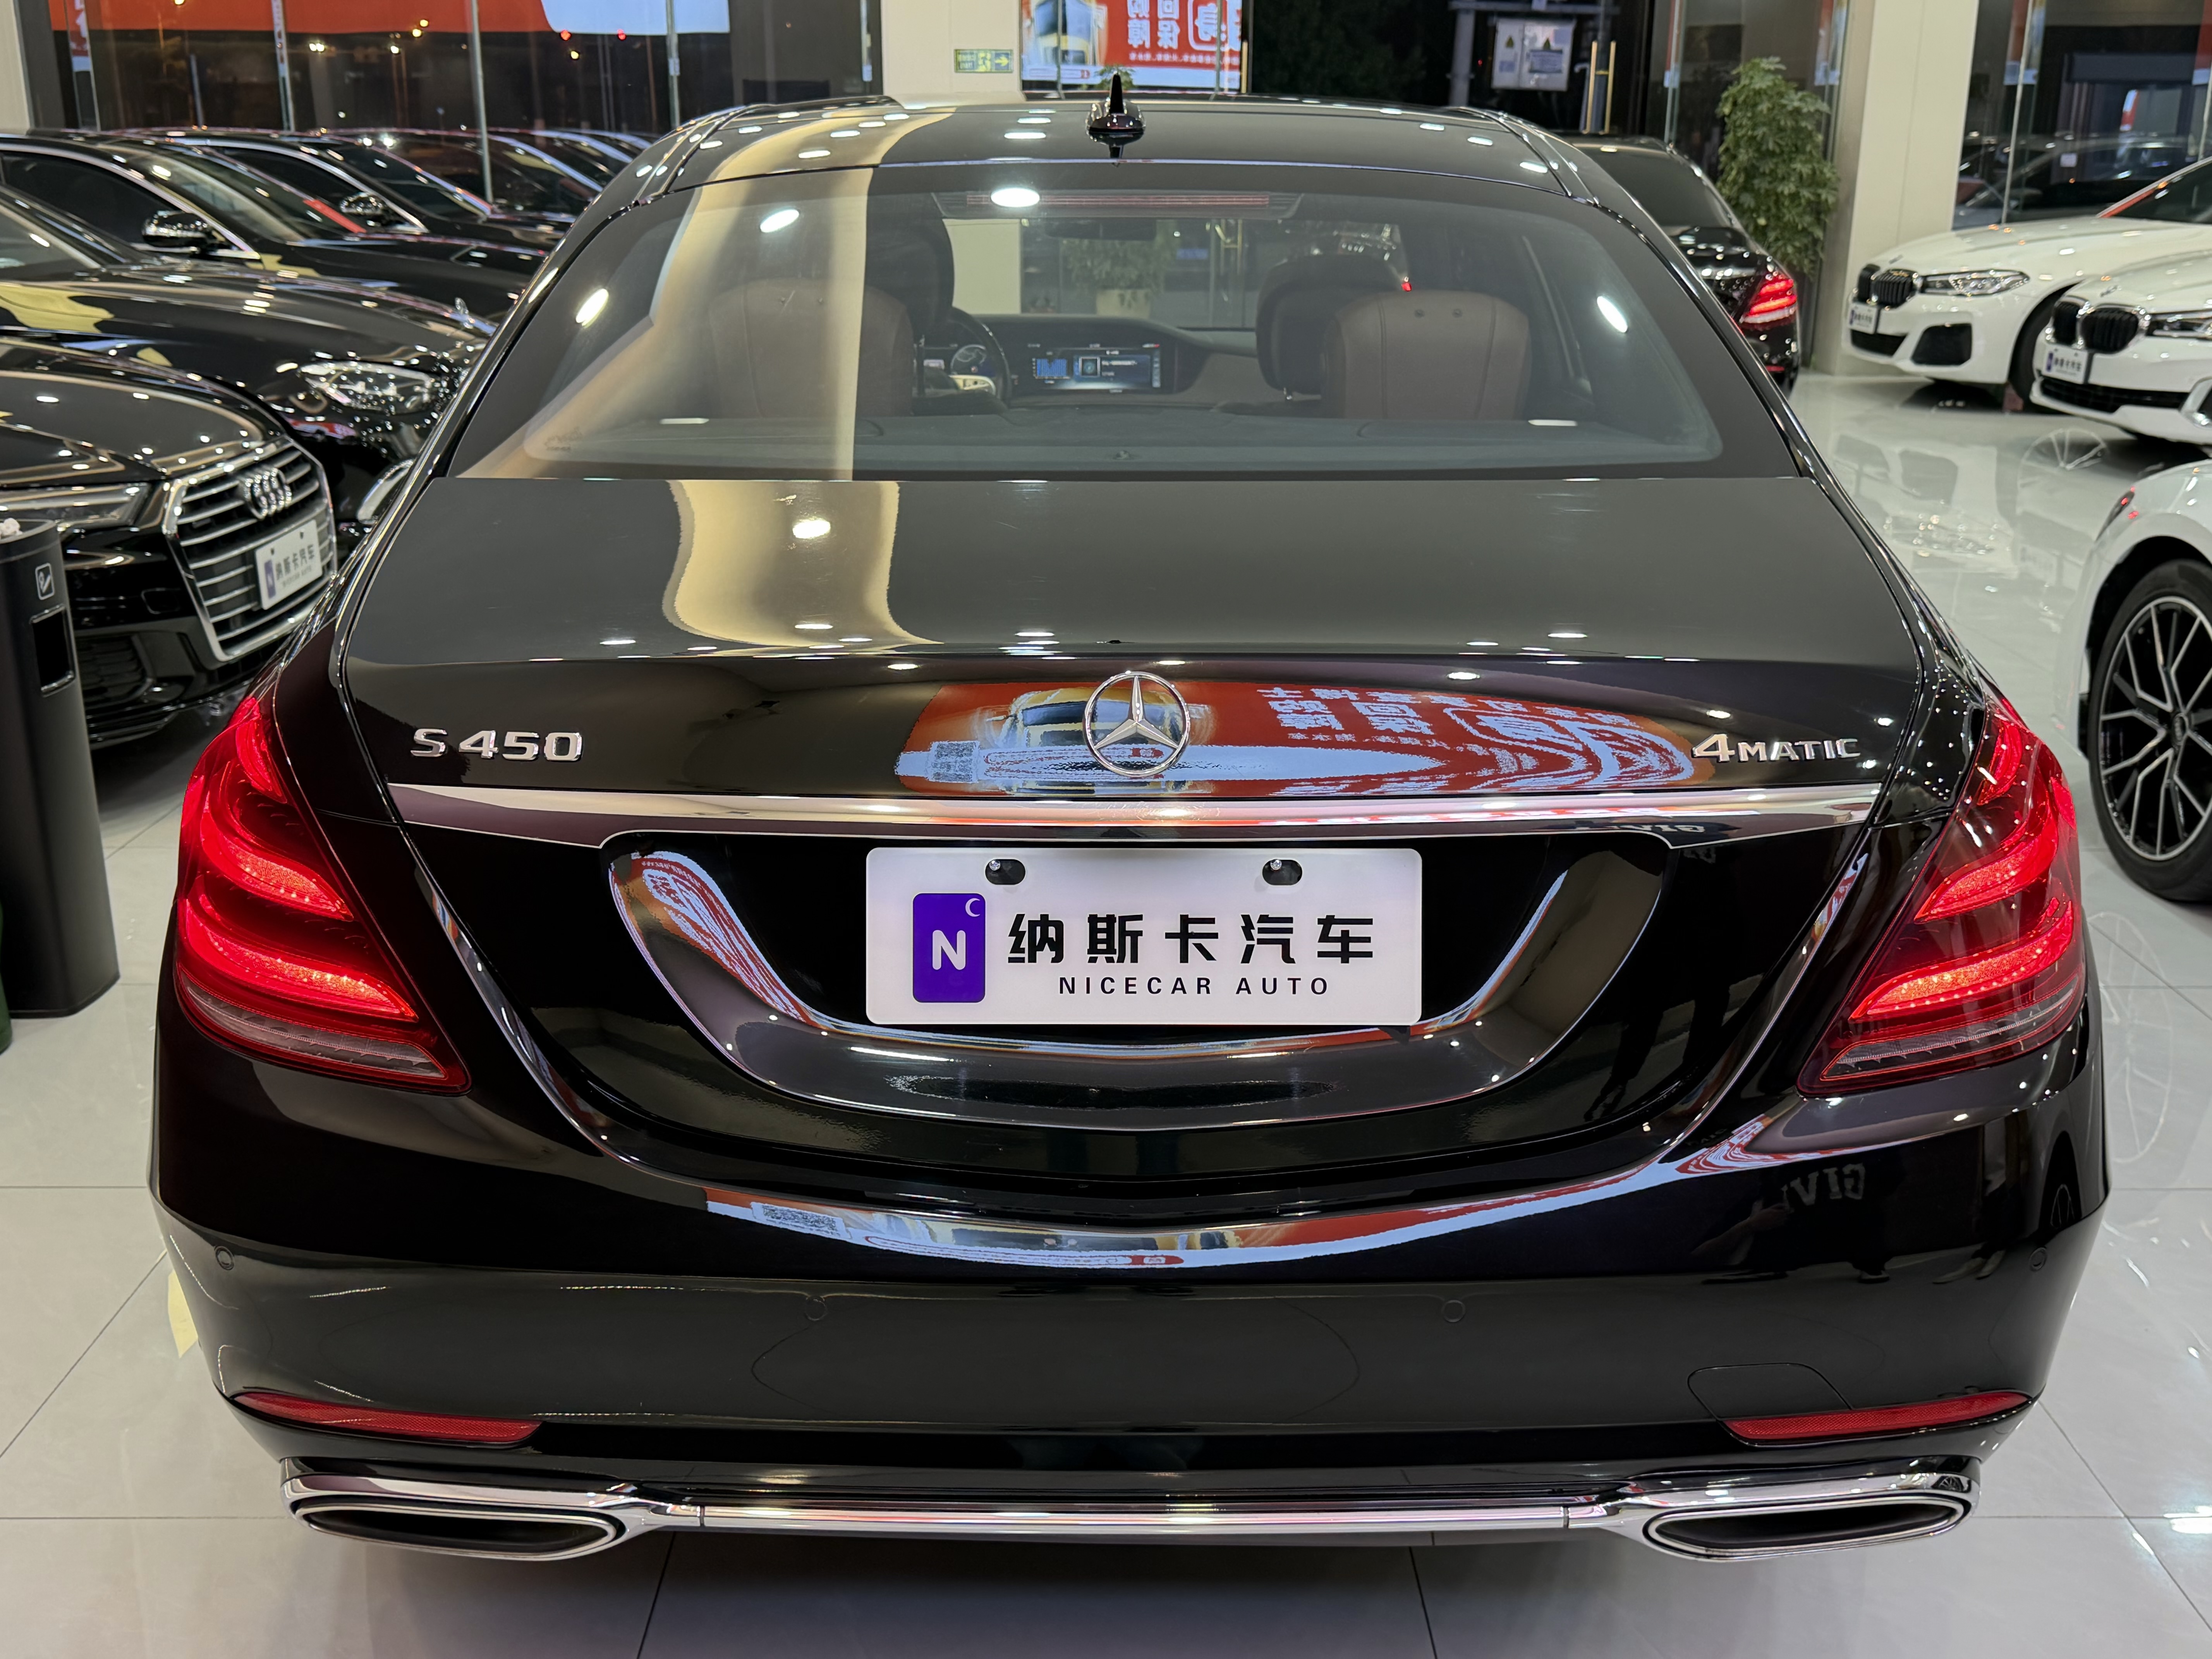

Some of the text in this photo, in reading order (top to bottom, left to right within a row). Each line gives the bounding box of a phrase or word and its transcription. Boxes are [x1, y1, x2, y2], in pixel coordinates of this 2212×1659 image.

[410, 728, 582, 761] S 450
[1692, 733, 1861, 762] 4MATIC
[932, 930, 966, 970] N
[1008, 914, 1373, 964] 纳斯卡汽车
[1060, 977, 1328, 995] NICECAR AUTO
